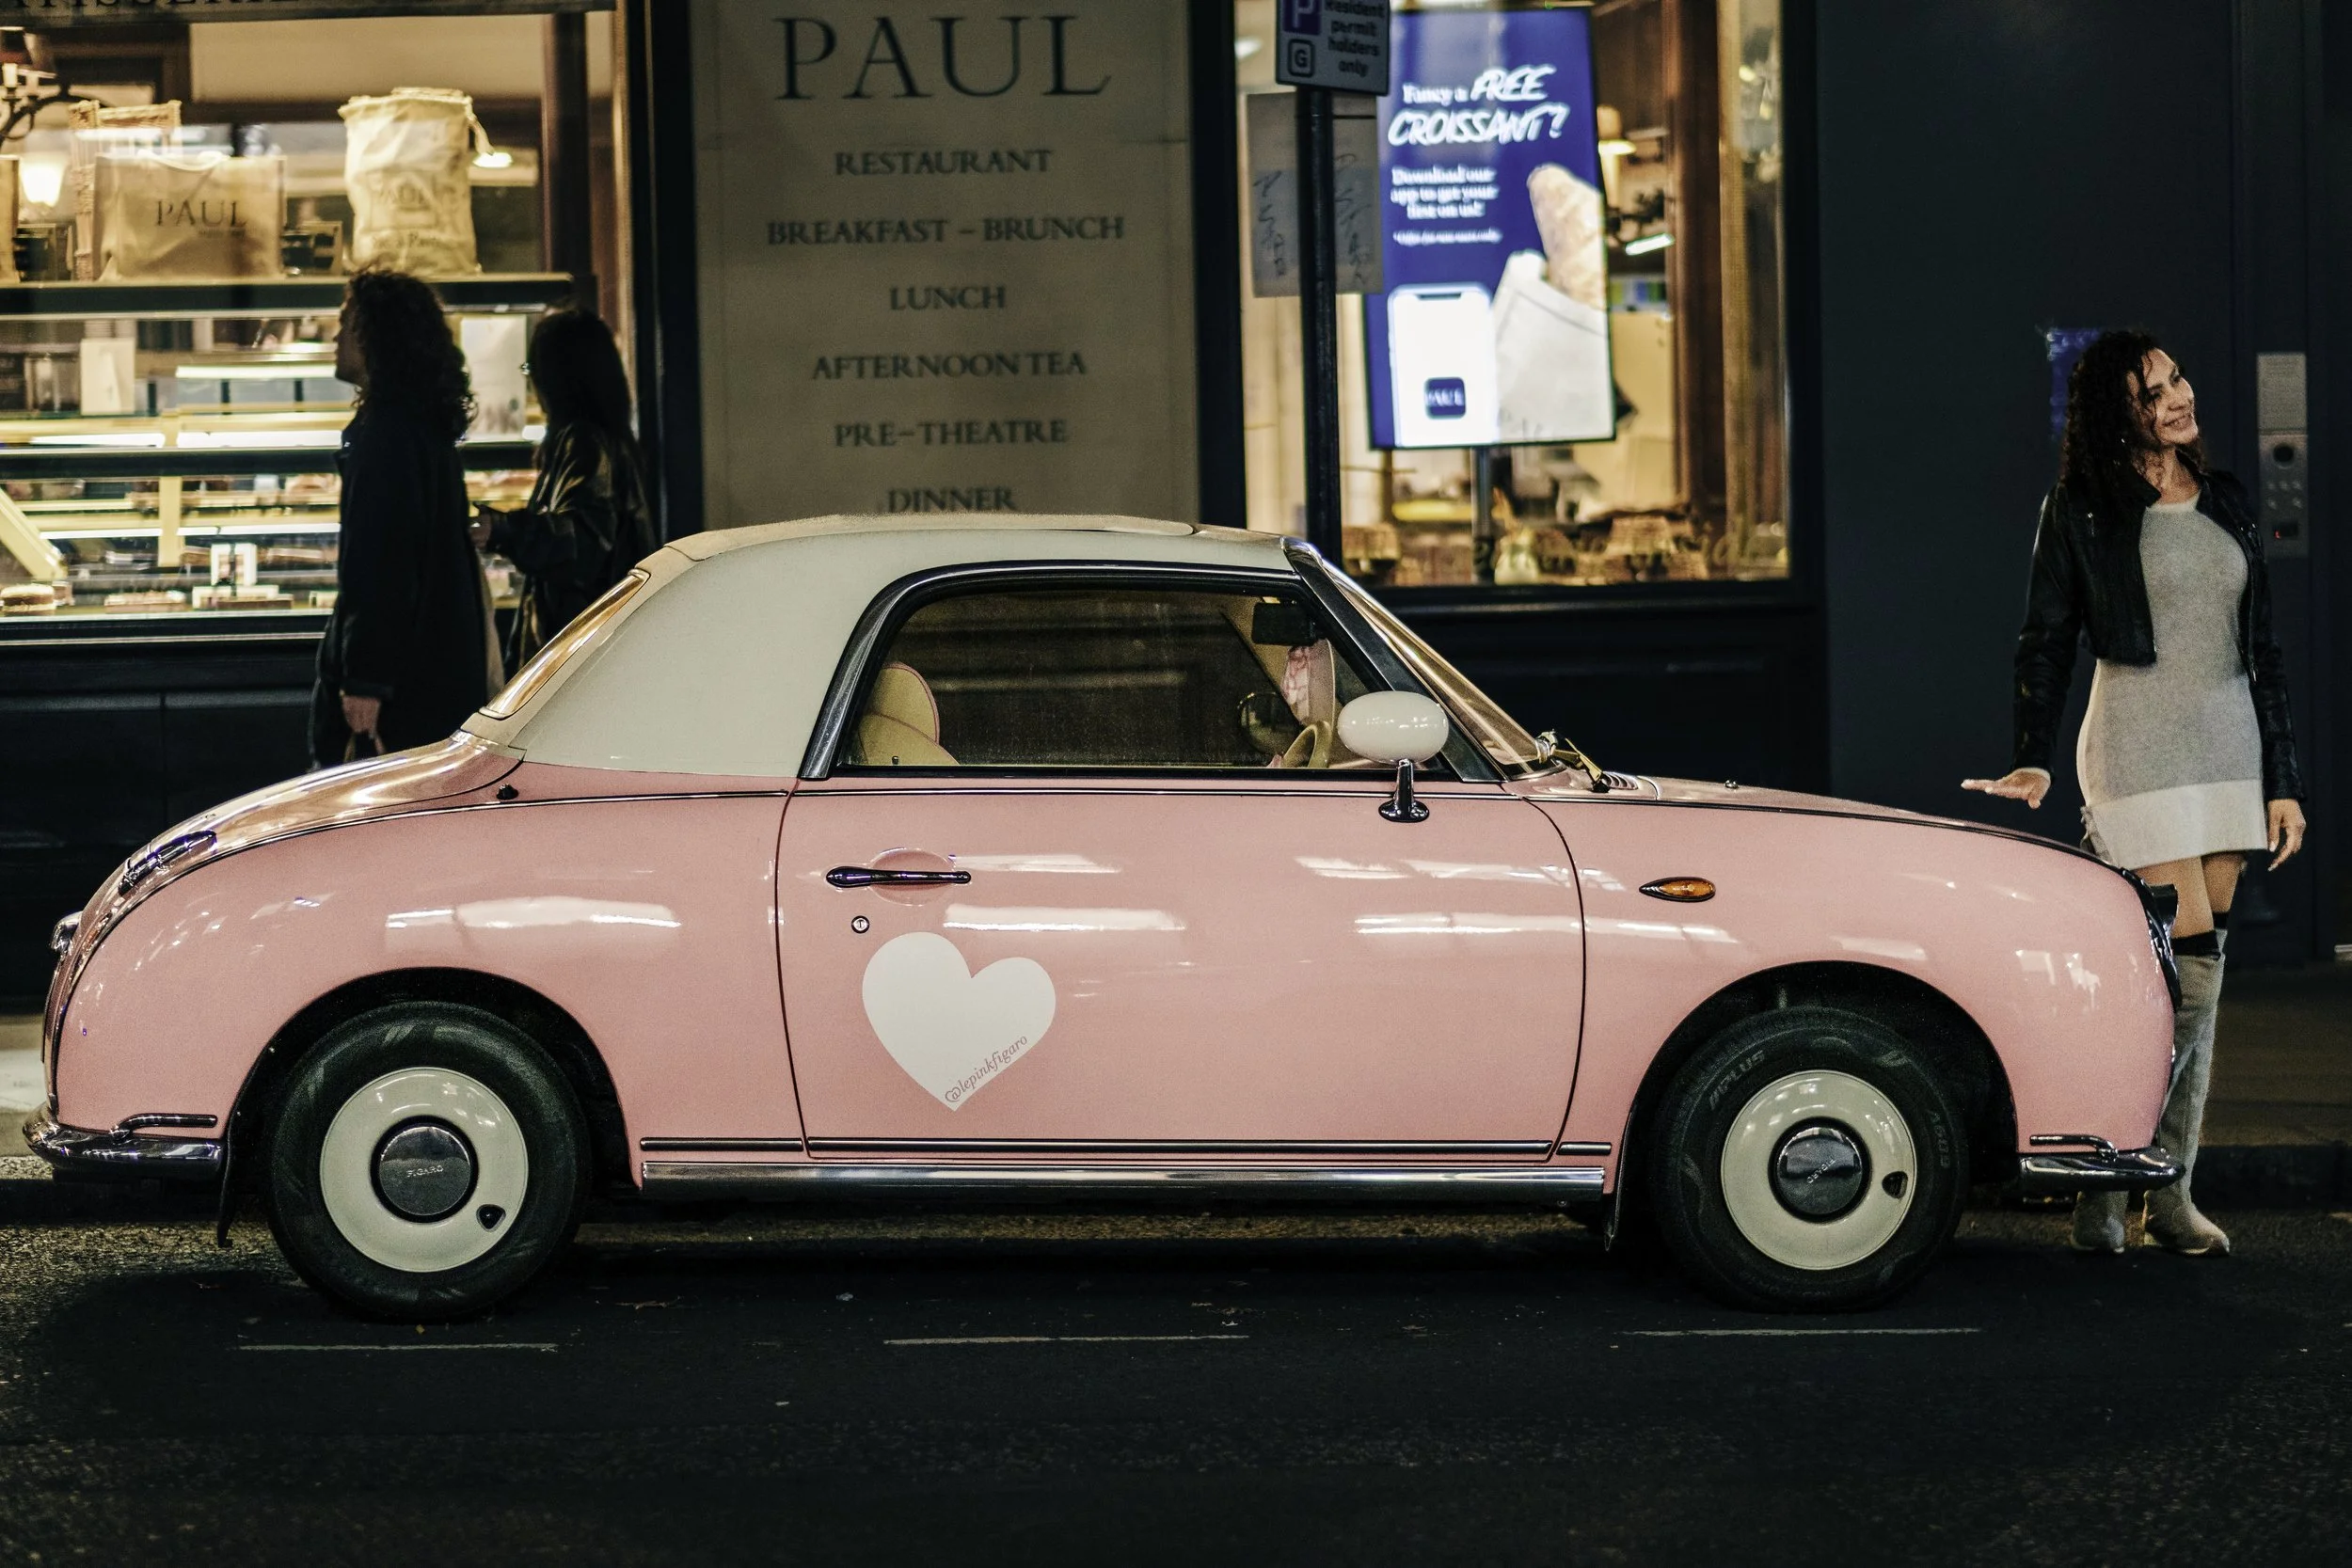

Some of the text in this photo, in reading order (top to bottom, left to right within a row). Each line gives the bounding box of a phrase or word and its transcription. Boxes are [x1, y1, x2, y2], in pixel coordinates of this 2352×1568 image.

[1293, 0, 1315, 28] P
[1330, 20, 1376, 38] permit
[772, 14, 1112, 101] PAUL
[1295, 50, 1308, 68] G
[1327, 37, 1380, 56] holders
[1338, 58, 1369, 77] only
[1470, 64, 1557, 101] FREE
[1388, 103, 1570, 146] CROISSANT?
[834, 148, 1052, 176] RESTAURANT
[156, 198, 248, 227] PAUL
[766, 218, 947, 245] BREAKFAST
[983, 216, 1124, 243] BRUNCH
[890, 285, 1007, 311] LUNCH
[812, 351, 1087, 380] AFTERNOON TEA
[834, 419, 1069, 448] PRE-THEATRE
[888, 486, 1018, 513] DINNER
[944, 1036, 1028, 1103] @lepinkfigaro
